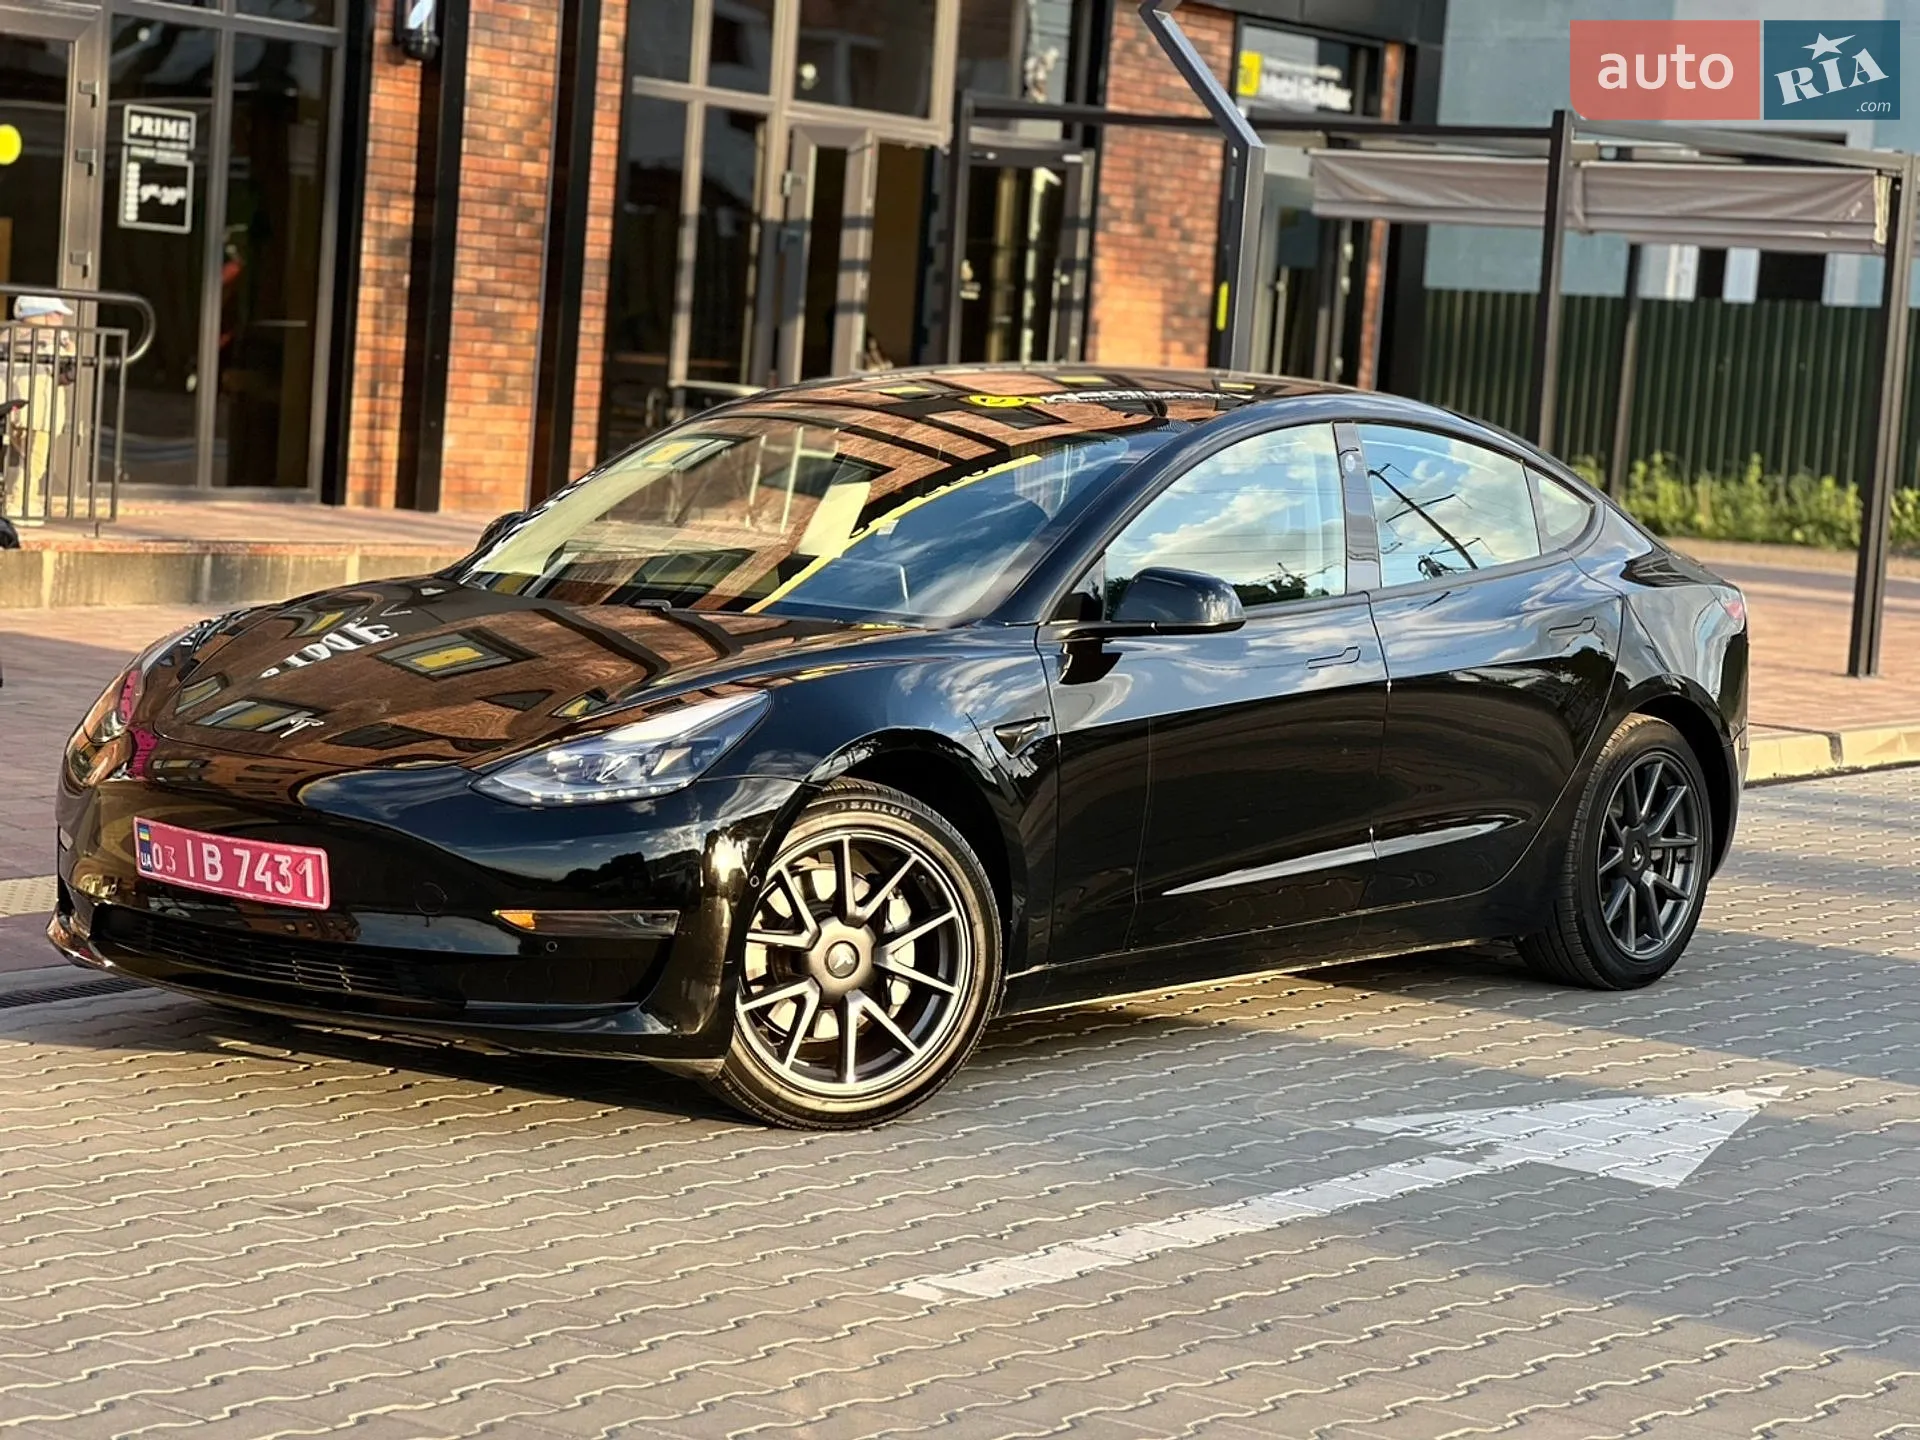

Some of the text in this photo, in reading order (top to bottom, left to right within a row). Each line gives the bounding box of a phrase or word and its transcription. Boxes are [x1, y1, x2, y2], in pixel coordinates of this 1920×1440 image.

[130, 115, 189, 141] PRIME
[850, 801, 912, 820] SAILUN
[141, 851, 152, 867] UA
[152, 839, 315, 899] 03 IB 7431
